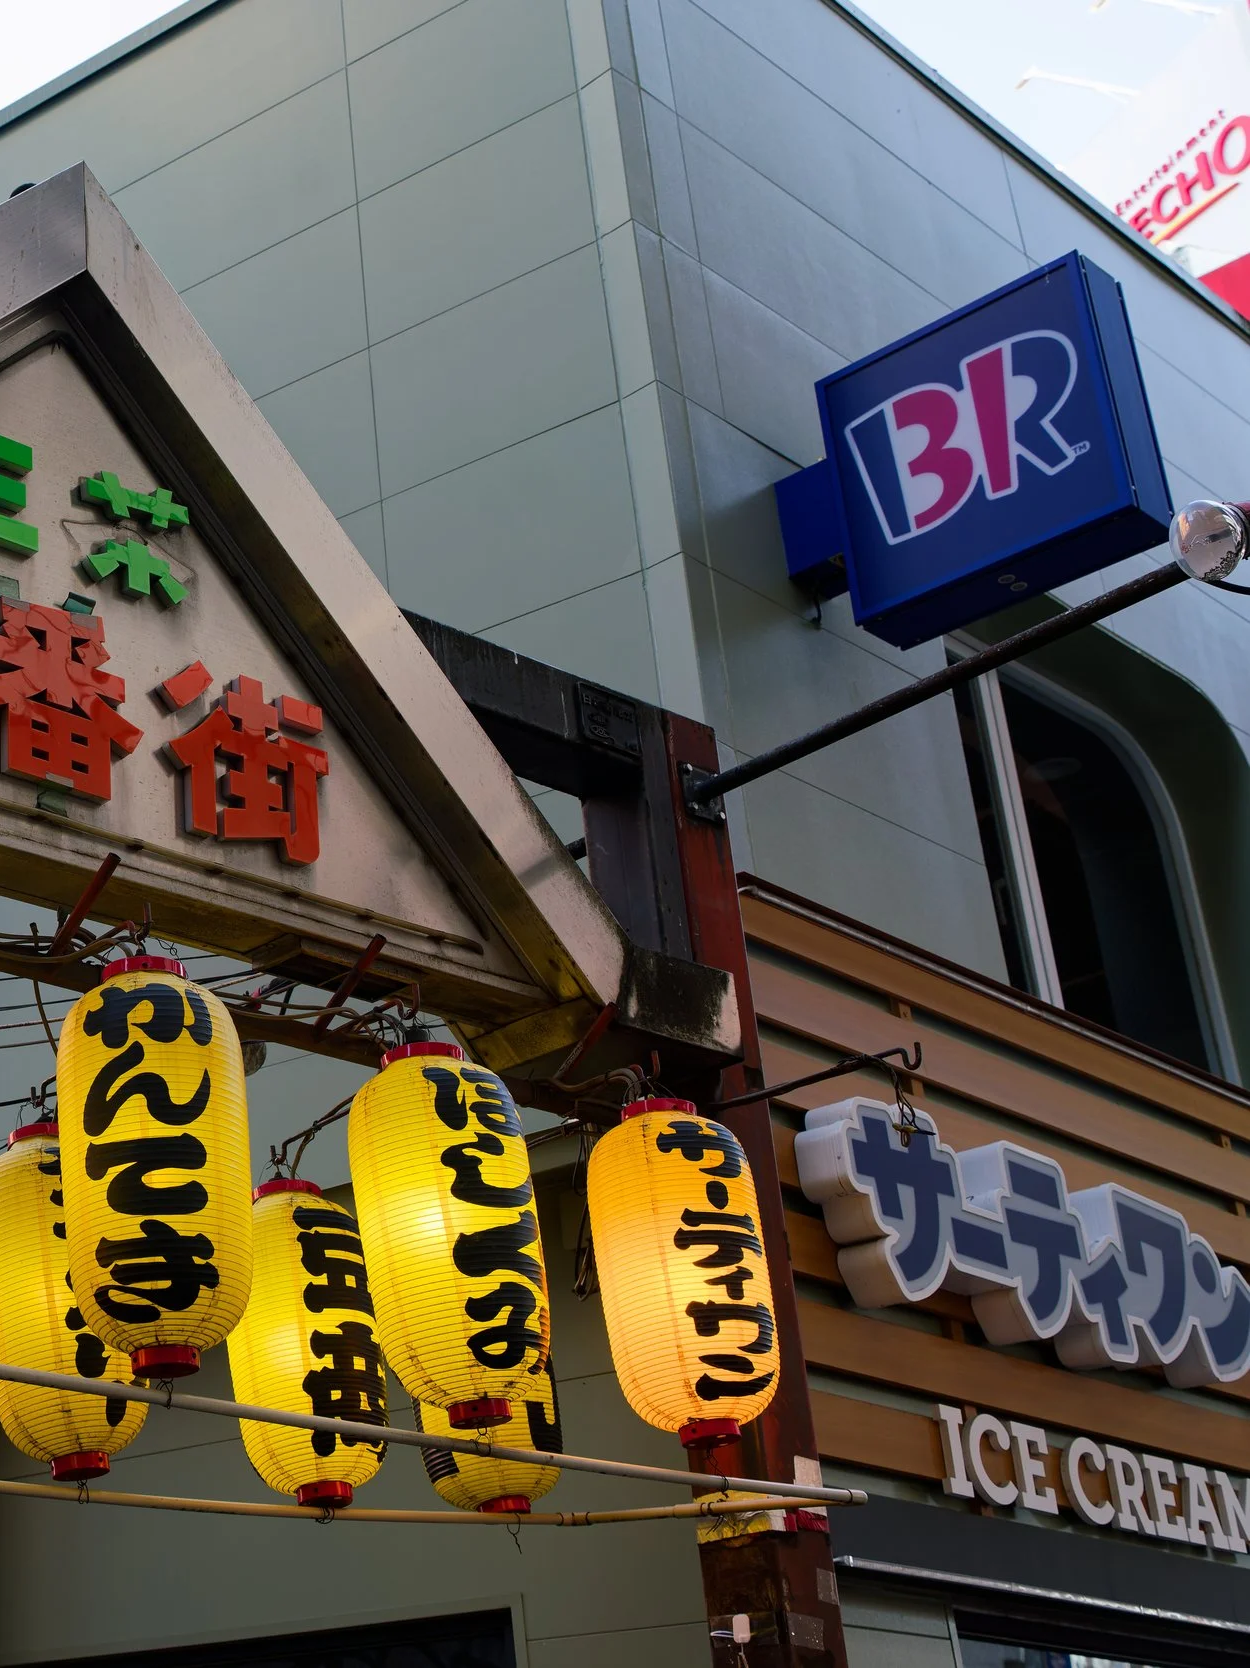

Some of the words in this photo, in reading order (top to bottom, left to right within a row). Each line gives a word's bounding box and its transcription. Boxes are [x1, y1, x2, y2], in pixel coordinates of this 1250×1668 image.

[851, 1114, 1250, 1366] サーティワン
[936, 1403, 1059, 1516] ICE
